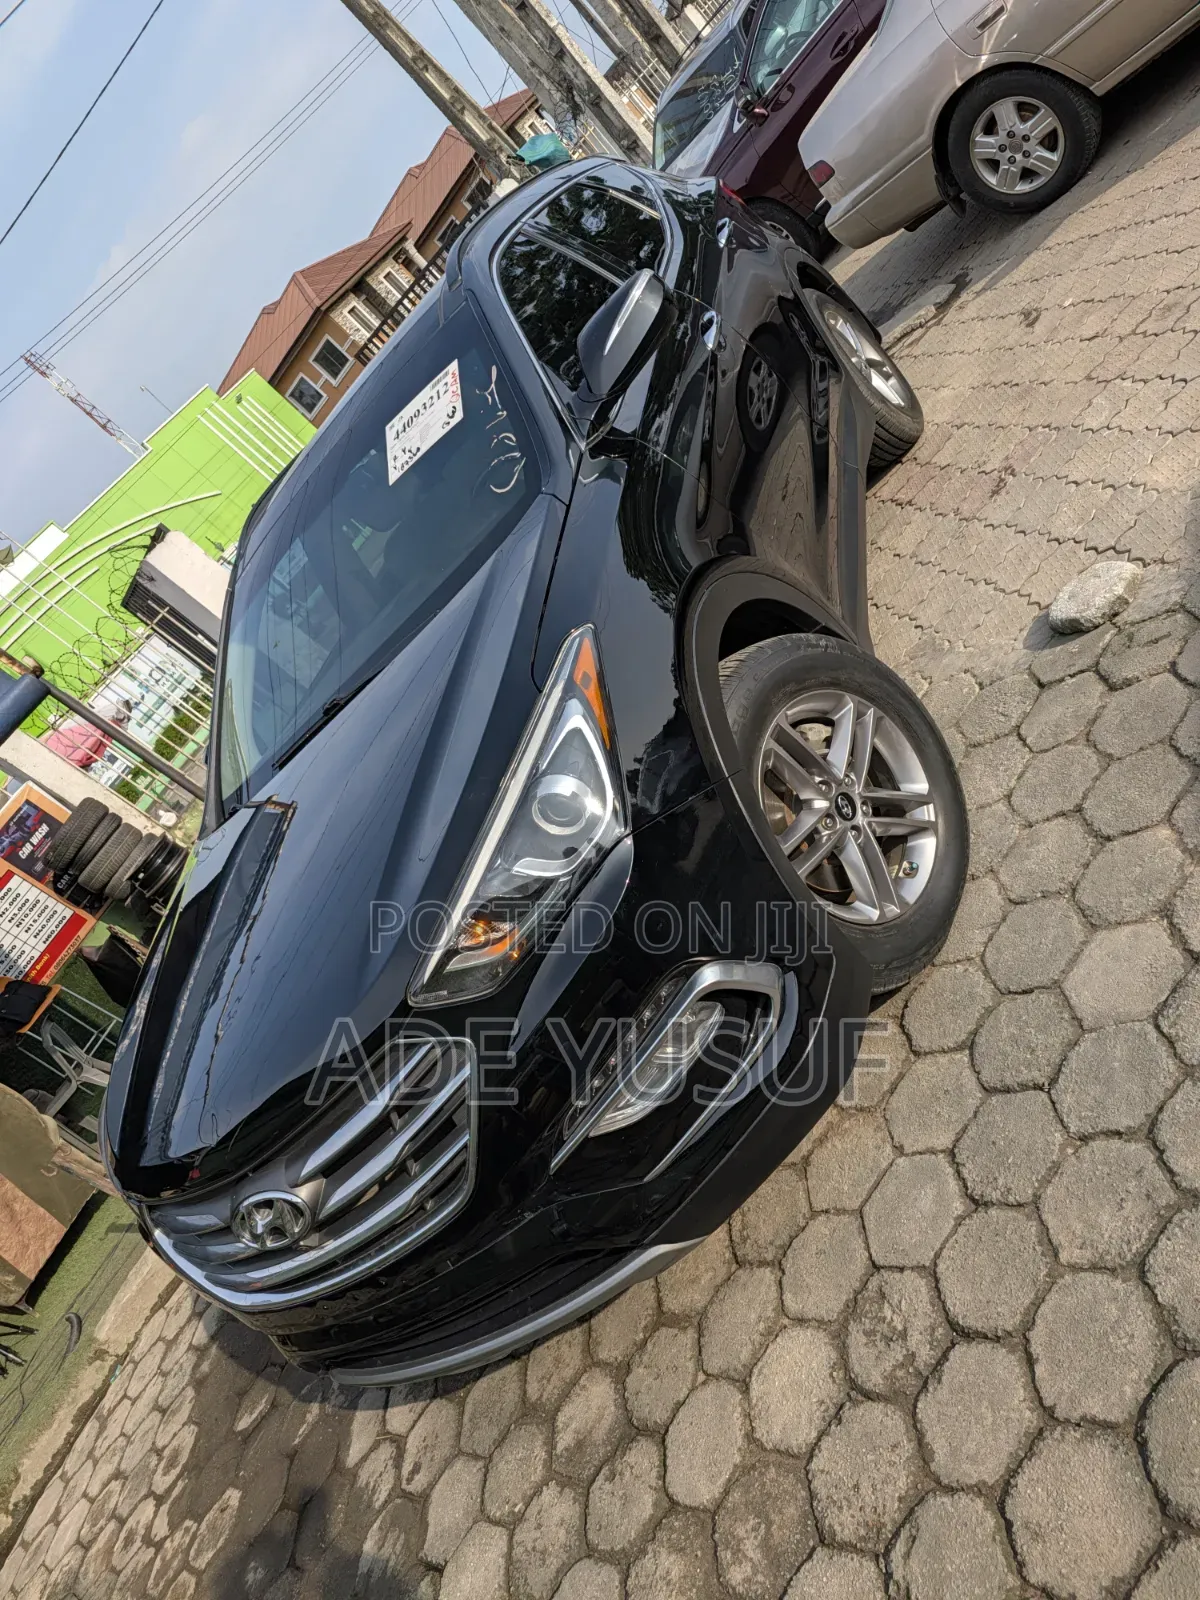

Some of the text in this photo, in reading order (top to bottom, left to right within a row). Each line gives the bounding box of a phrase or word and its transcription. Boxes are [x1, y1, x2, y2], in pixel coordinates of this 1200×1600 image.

[393, 381, 451, 443] 44093212
[19, 841, 34, 859] CAR
[30, 823, 50, 846] WASH
[57, 873, 71, 889] CAR
